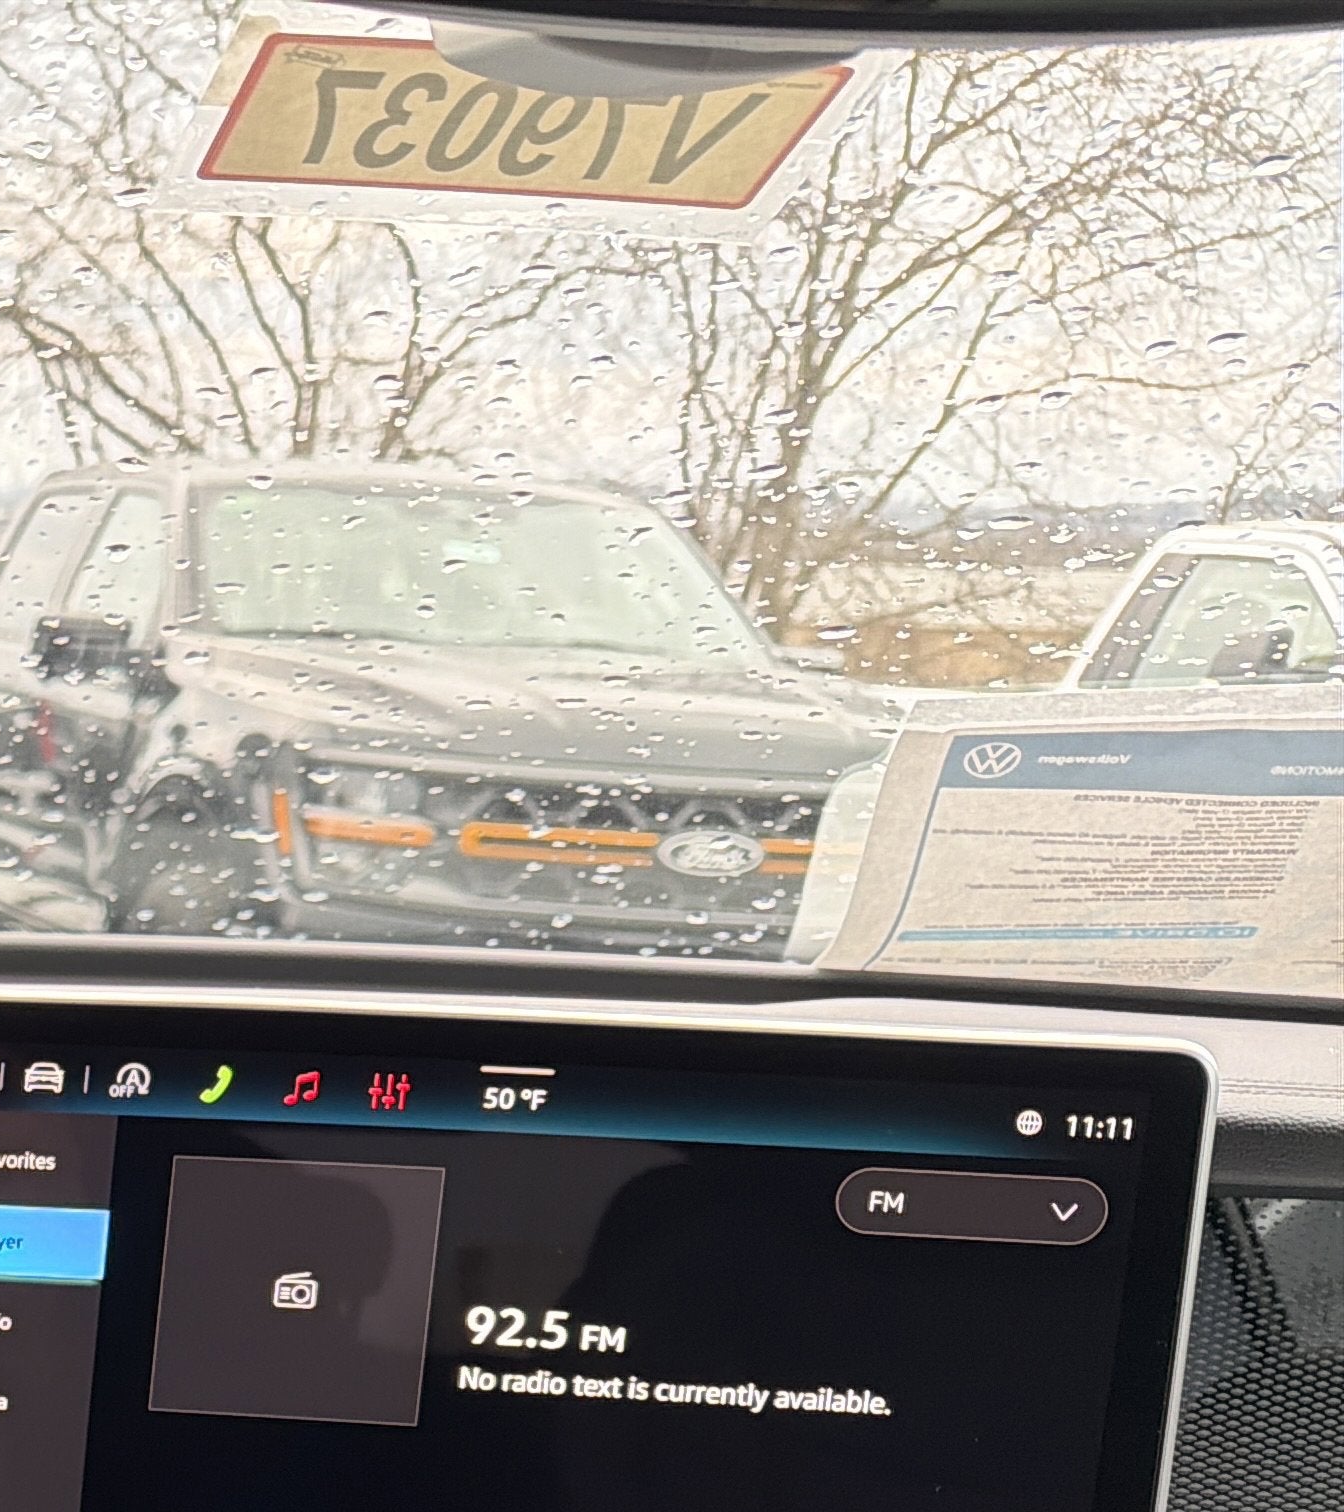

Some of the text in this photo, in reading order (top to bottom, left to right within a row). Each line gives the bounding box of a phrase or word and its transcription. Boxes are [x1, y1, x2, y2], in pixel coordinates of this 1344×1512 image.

[109, 1084, 135, 1098] OFF
[482, 1087, 513, 1110] 50
[1065, 1114, 1135, 1140] 11:11
[868, 1190, 905, 1215] FM
[465, 1305, 627, 1354] 92.5 FM
[457, 1365, 892, 1417] No radio text is currently available.
